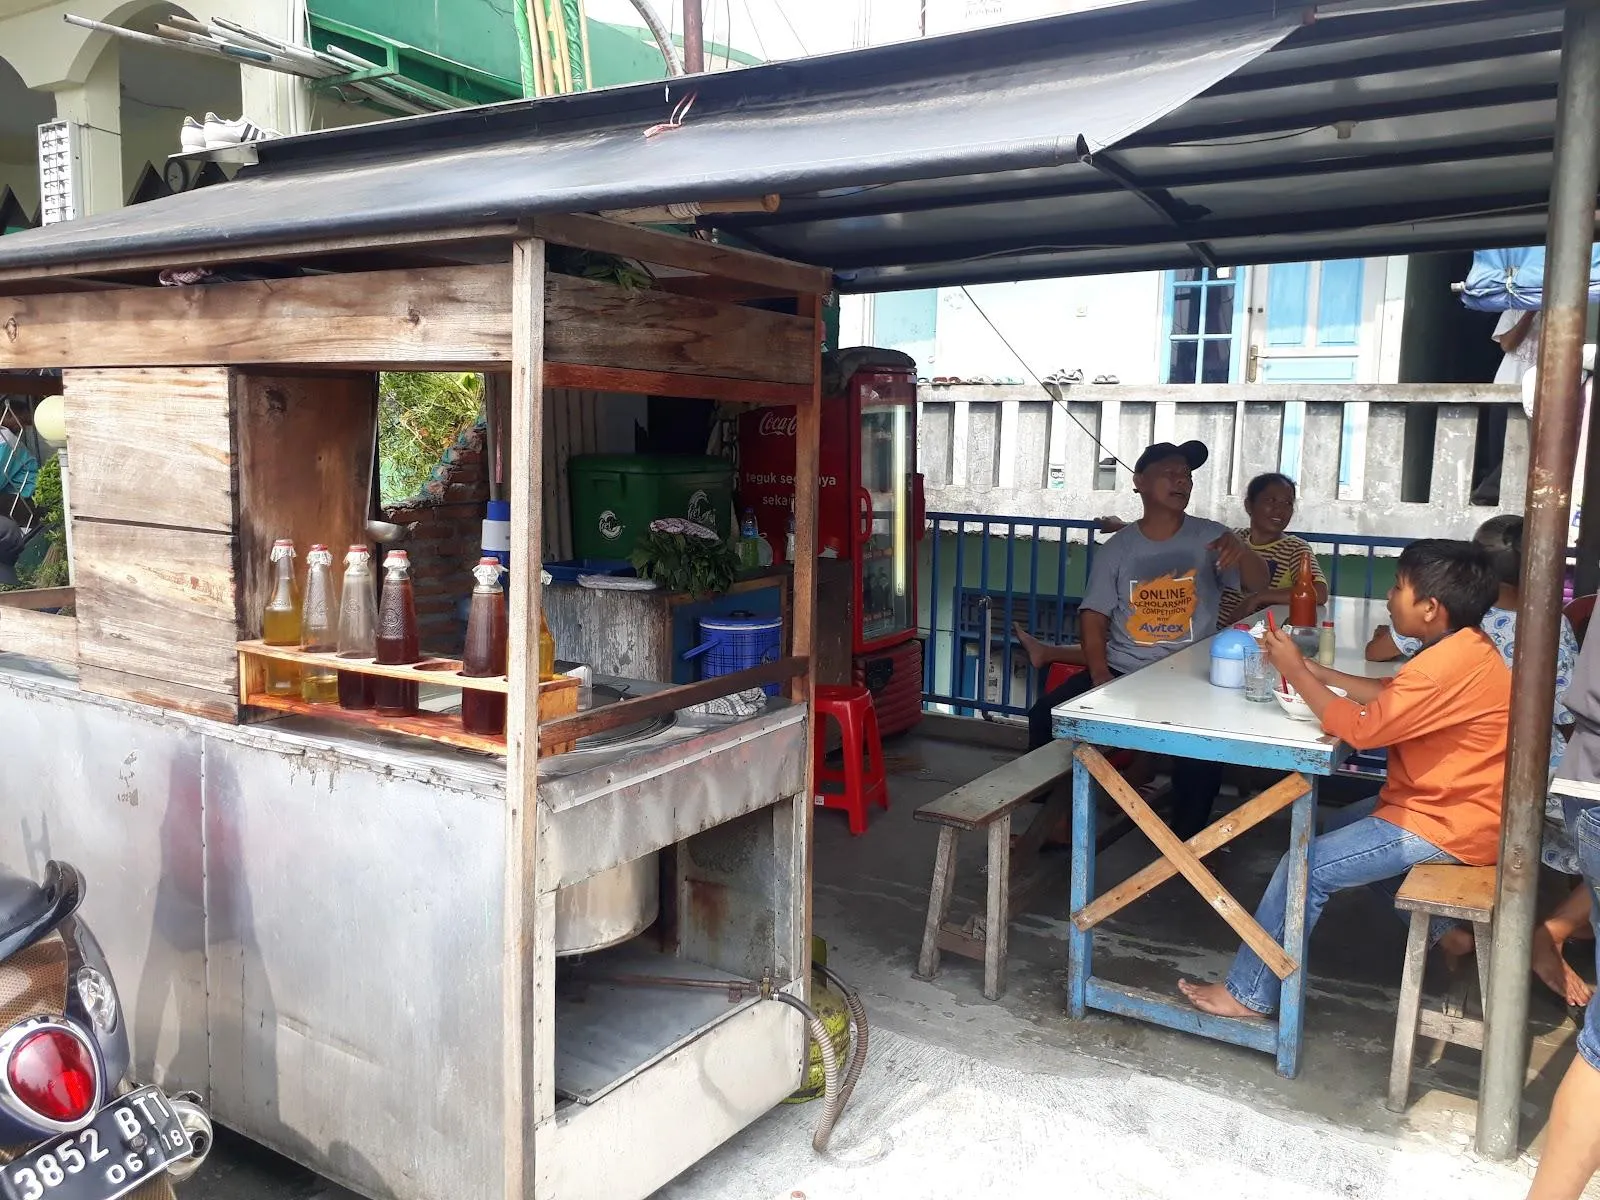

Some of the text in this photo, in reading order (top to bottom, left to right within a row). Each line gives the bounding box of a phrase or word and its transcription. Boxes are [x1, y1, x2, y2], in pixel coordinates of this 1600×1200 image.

[746, 472, 777, 485] teguk
[1140, 588, 1185, 600] ONLINE
[1134, 597, 1192, 608] SCHOLARSHIP
[1142, 607, 1185, 615] COMPETITION
[1139, 623, 1183, 632] Avitex
[14, 1092, 170, 1200] 3852 BTT
